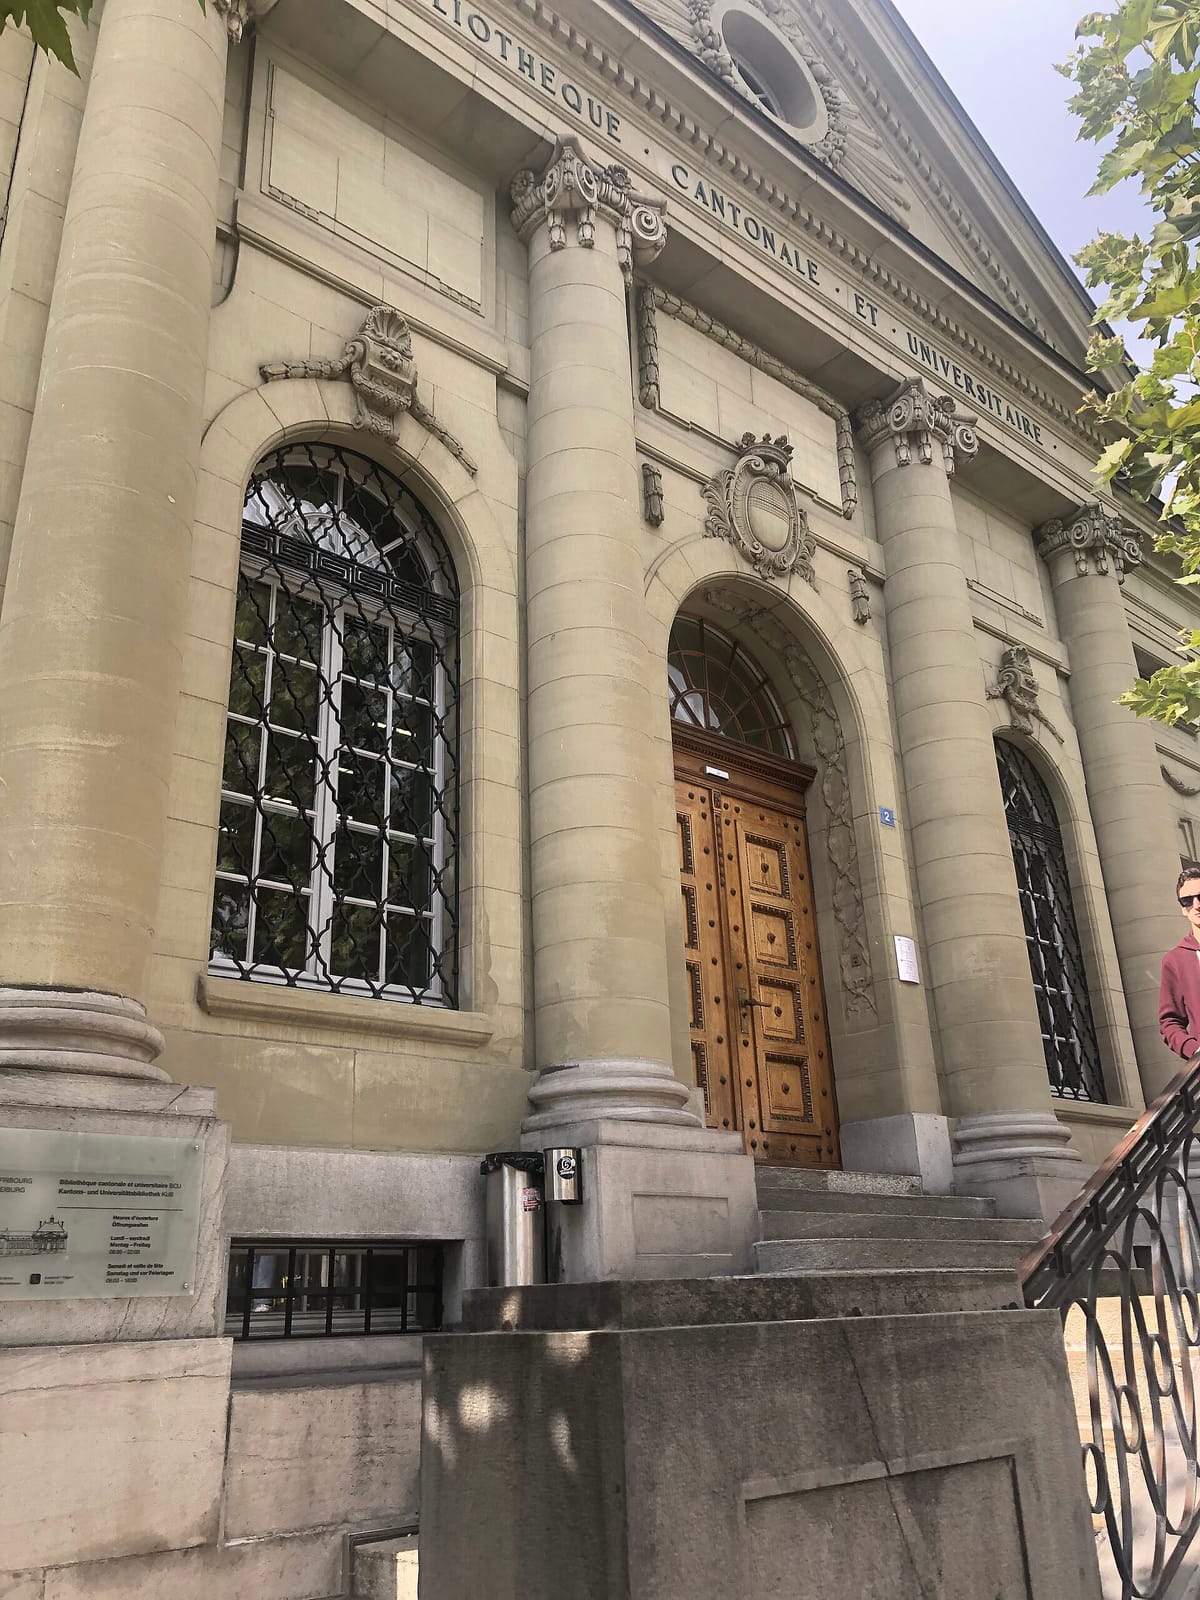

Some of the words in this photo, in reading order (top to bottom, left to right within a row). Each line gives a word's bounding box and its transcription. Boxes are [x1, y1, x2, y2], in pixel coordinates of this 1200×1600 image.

[671, 165, 821, 287] CANTONALE
[854, 293, 879, 328] ET
[906, 332, 1044, 447] UNIVERSITAIRE
[883, 811, 891, 822] 2
